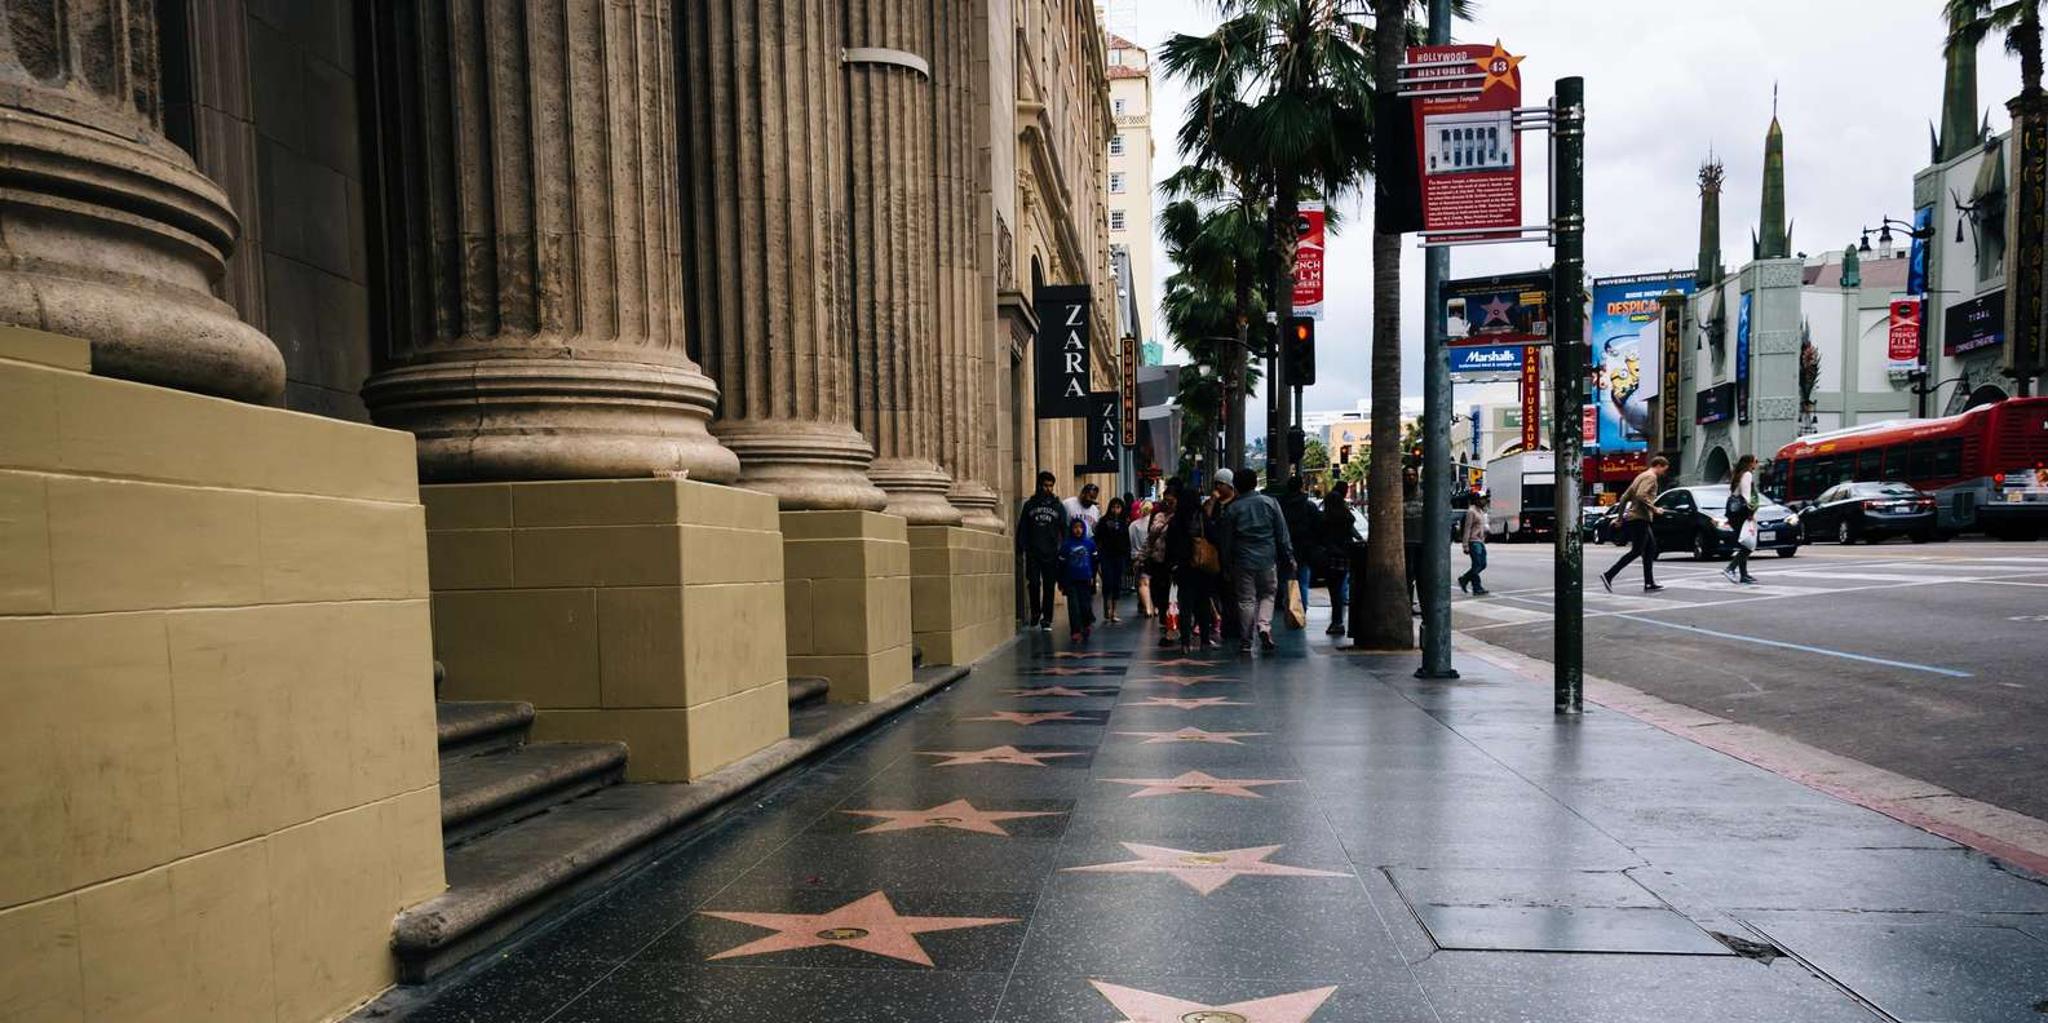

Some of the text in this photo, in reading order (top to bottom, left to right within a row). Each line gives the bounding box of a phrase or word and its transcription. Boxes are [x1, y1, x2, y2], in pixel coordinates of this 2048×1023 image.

[1417, 51, 1467, 62] HOLLYWOOD
[1418, 67, 1466, 77] HISTORIC
[1491, 61, 1507, 72] 43
[1296, 261, 1320, 269] ENCH
[1597, 277, 1636, 285] UNIVERSAL
[1064, 304, 1086, 398] ZARA
[1466, 350, 1515, 362] Marshalls
[1663, 320, 1678, 438] CHINESE
[1123, 341, 1134, 443] SOUVENIRS
[1102, 403, 1116, 461] ZARA
